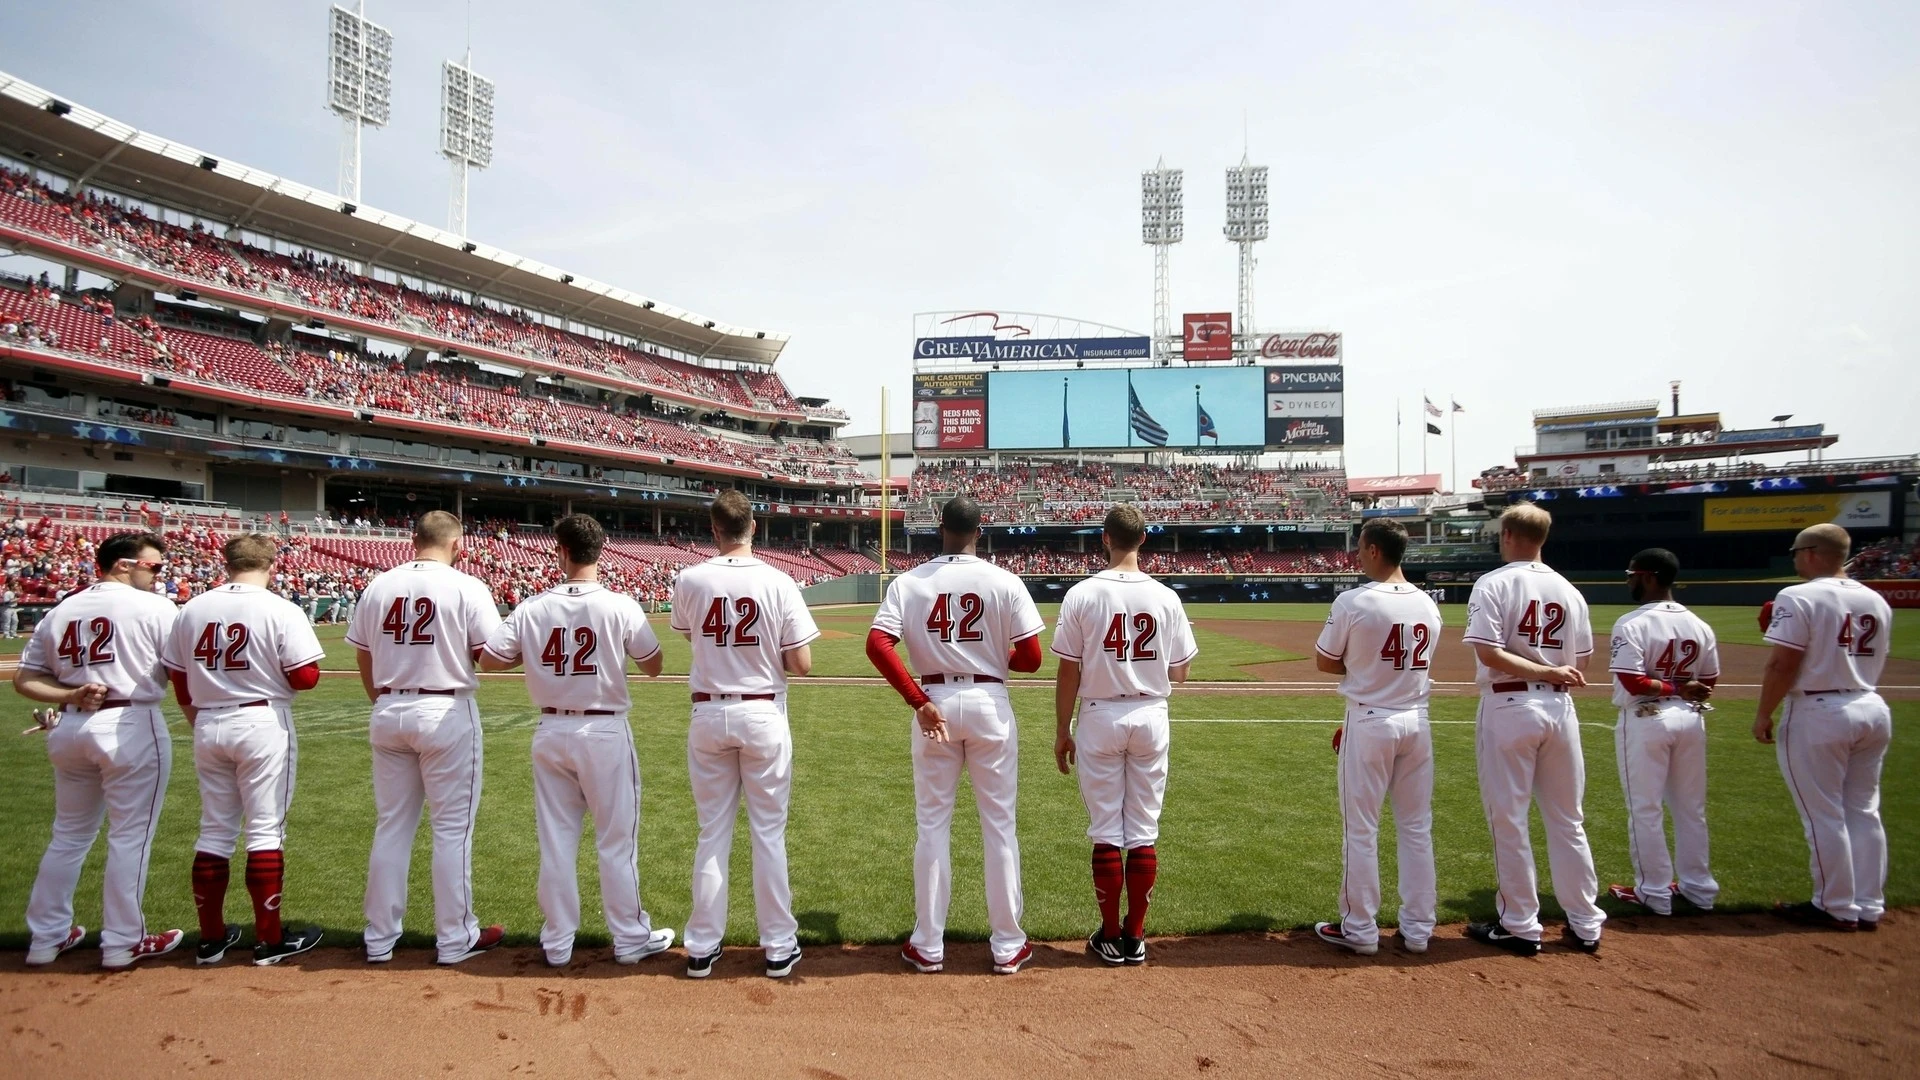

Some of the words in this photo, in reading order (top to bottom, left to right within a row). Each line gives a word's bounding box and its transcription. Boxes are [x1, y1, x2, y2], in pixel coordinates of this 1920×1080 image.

[918, 339, 983, 356] GREAT
[977, 342, 1078, 359] AMERICAN
[1083, 349, 1121, 357] INSURANCE
[1123, 348, 1146, 356] GROUP
[1262, 333, 1339, 358] Coca-Cola
[960, 417, 981, 425] BUD'S
[962, 409, 981, 417] FANS,
[1289, 401, 1336, 409] DYNEGY
[1299, 420, 1317, 430] John
[957, 425, 974, 433] YOU.
[1281, 424, 1329, 442] Morrell
[1711, 507, 1728, 516] For
[383, 597, 435, 645] 42
[702, 597, 759, 647] 42
[927, 593, 984, 642] 42
[1103, 613, 1157, 662] 42
[1517, 600, 1566, 649] 42
[1837, 613, 1880, 656] 42
[57, 617, 115, 668] 42
[194, 623, 250, 672] 42
[541, 626, 597, 676] 42
[1380, 623, 1429, 670] 42
[1655, 639, 1699, 680] 42
